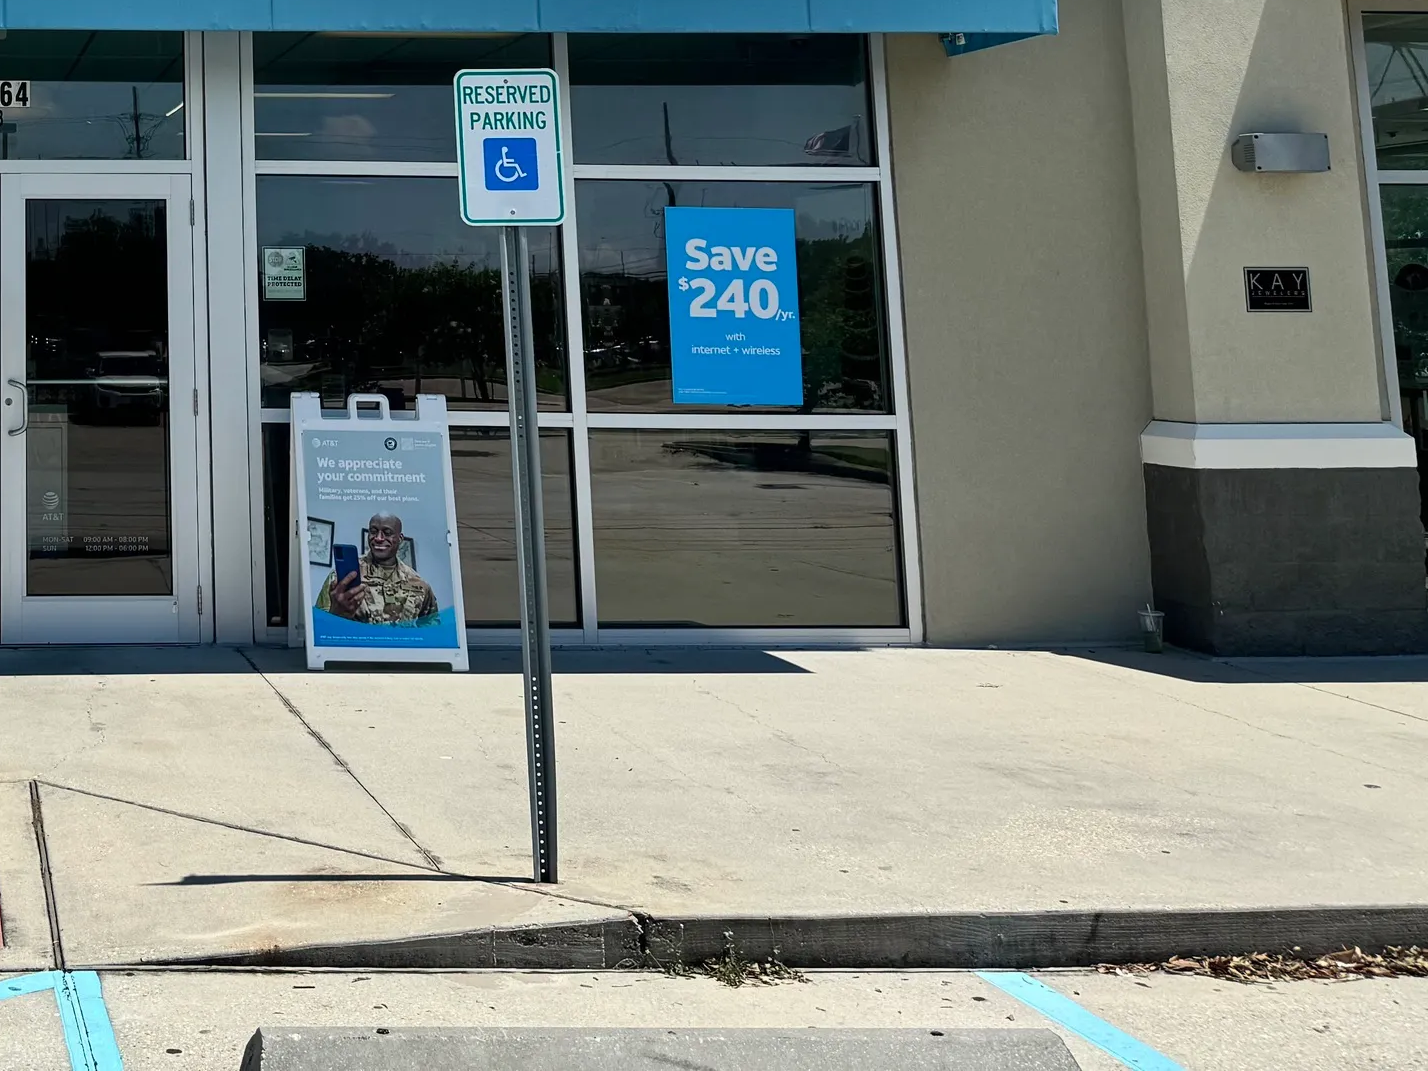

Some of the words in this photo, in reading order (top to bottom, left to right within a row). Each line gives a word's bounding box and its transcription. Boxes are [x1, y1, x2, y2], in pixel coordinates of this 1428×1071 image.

[462, 85, 551, 105] RESERVED
[469, 110, 547, 131] PARKING
[684, 237, 778, 272] Save
[725, 332, 746, 341] with
[691, 344, 731, 355] internet
[742, 345, 781, 356] wireless
[321, 439, 339, 447] AT&T
[316, 457, 336, 468] We
[338, 457, 403, 471] appreciate
[316, 472, 346, 484] your
[347, 470, 426, 483] commitment
[342, 494, 353, 502] get
[42, 513, 64, 521] AT&T
